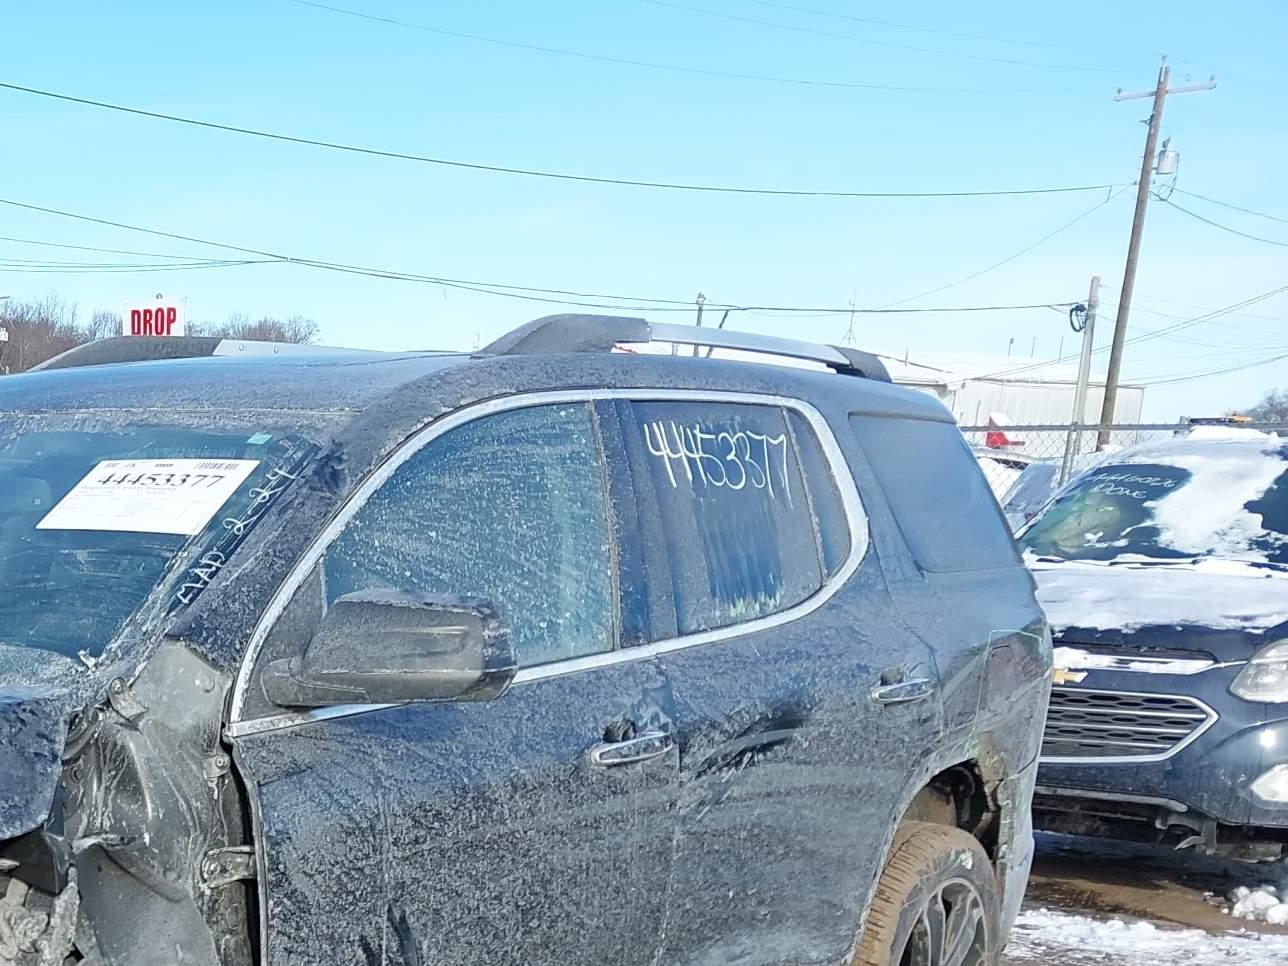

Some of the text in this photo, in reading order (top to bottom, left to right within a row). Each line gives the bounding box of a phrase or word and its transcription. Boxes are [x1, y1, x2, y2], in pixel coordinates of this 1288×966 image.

[130, 307, 177, 336] DROP
[644, 420, 794, 509] 44453377
[97, 472, 227, 488] 44453377
